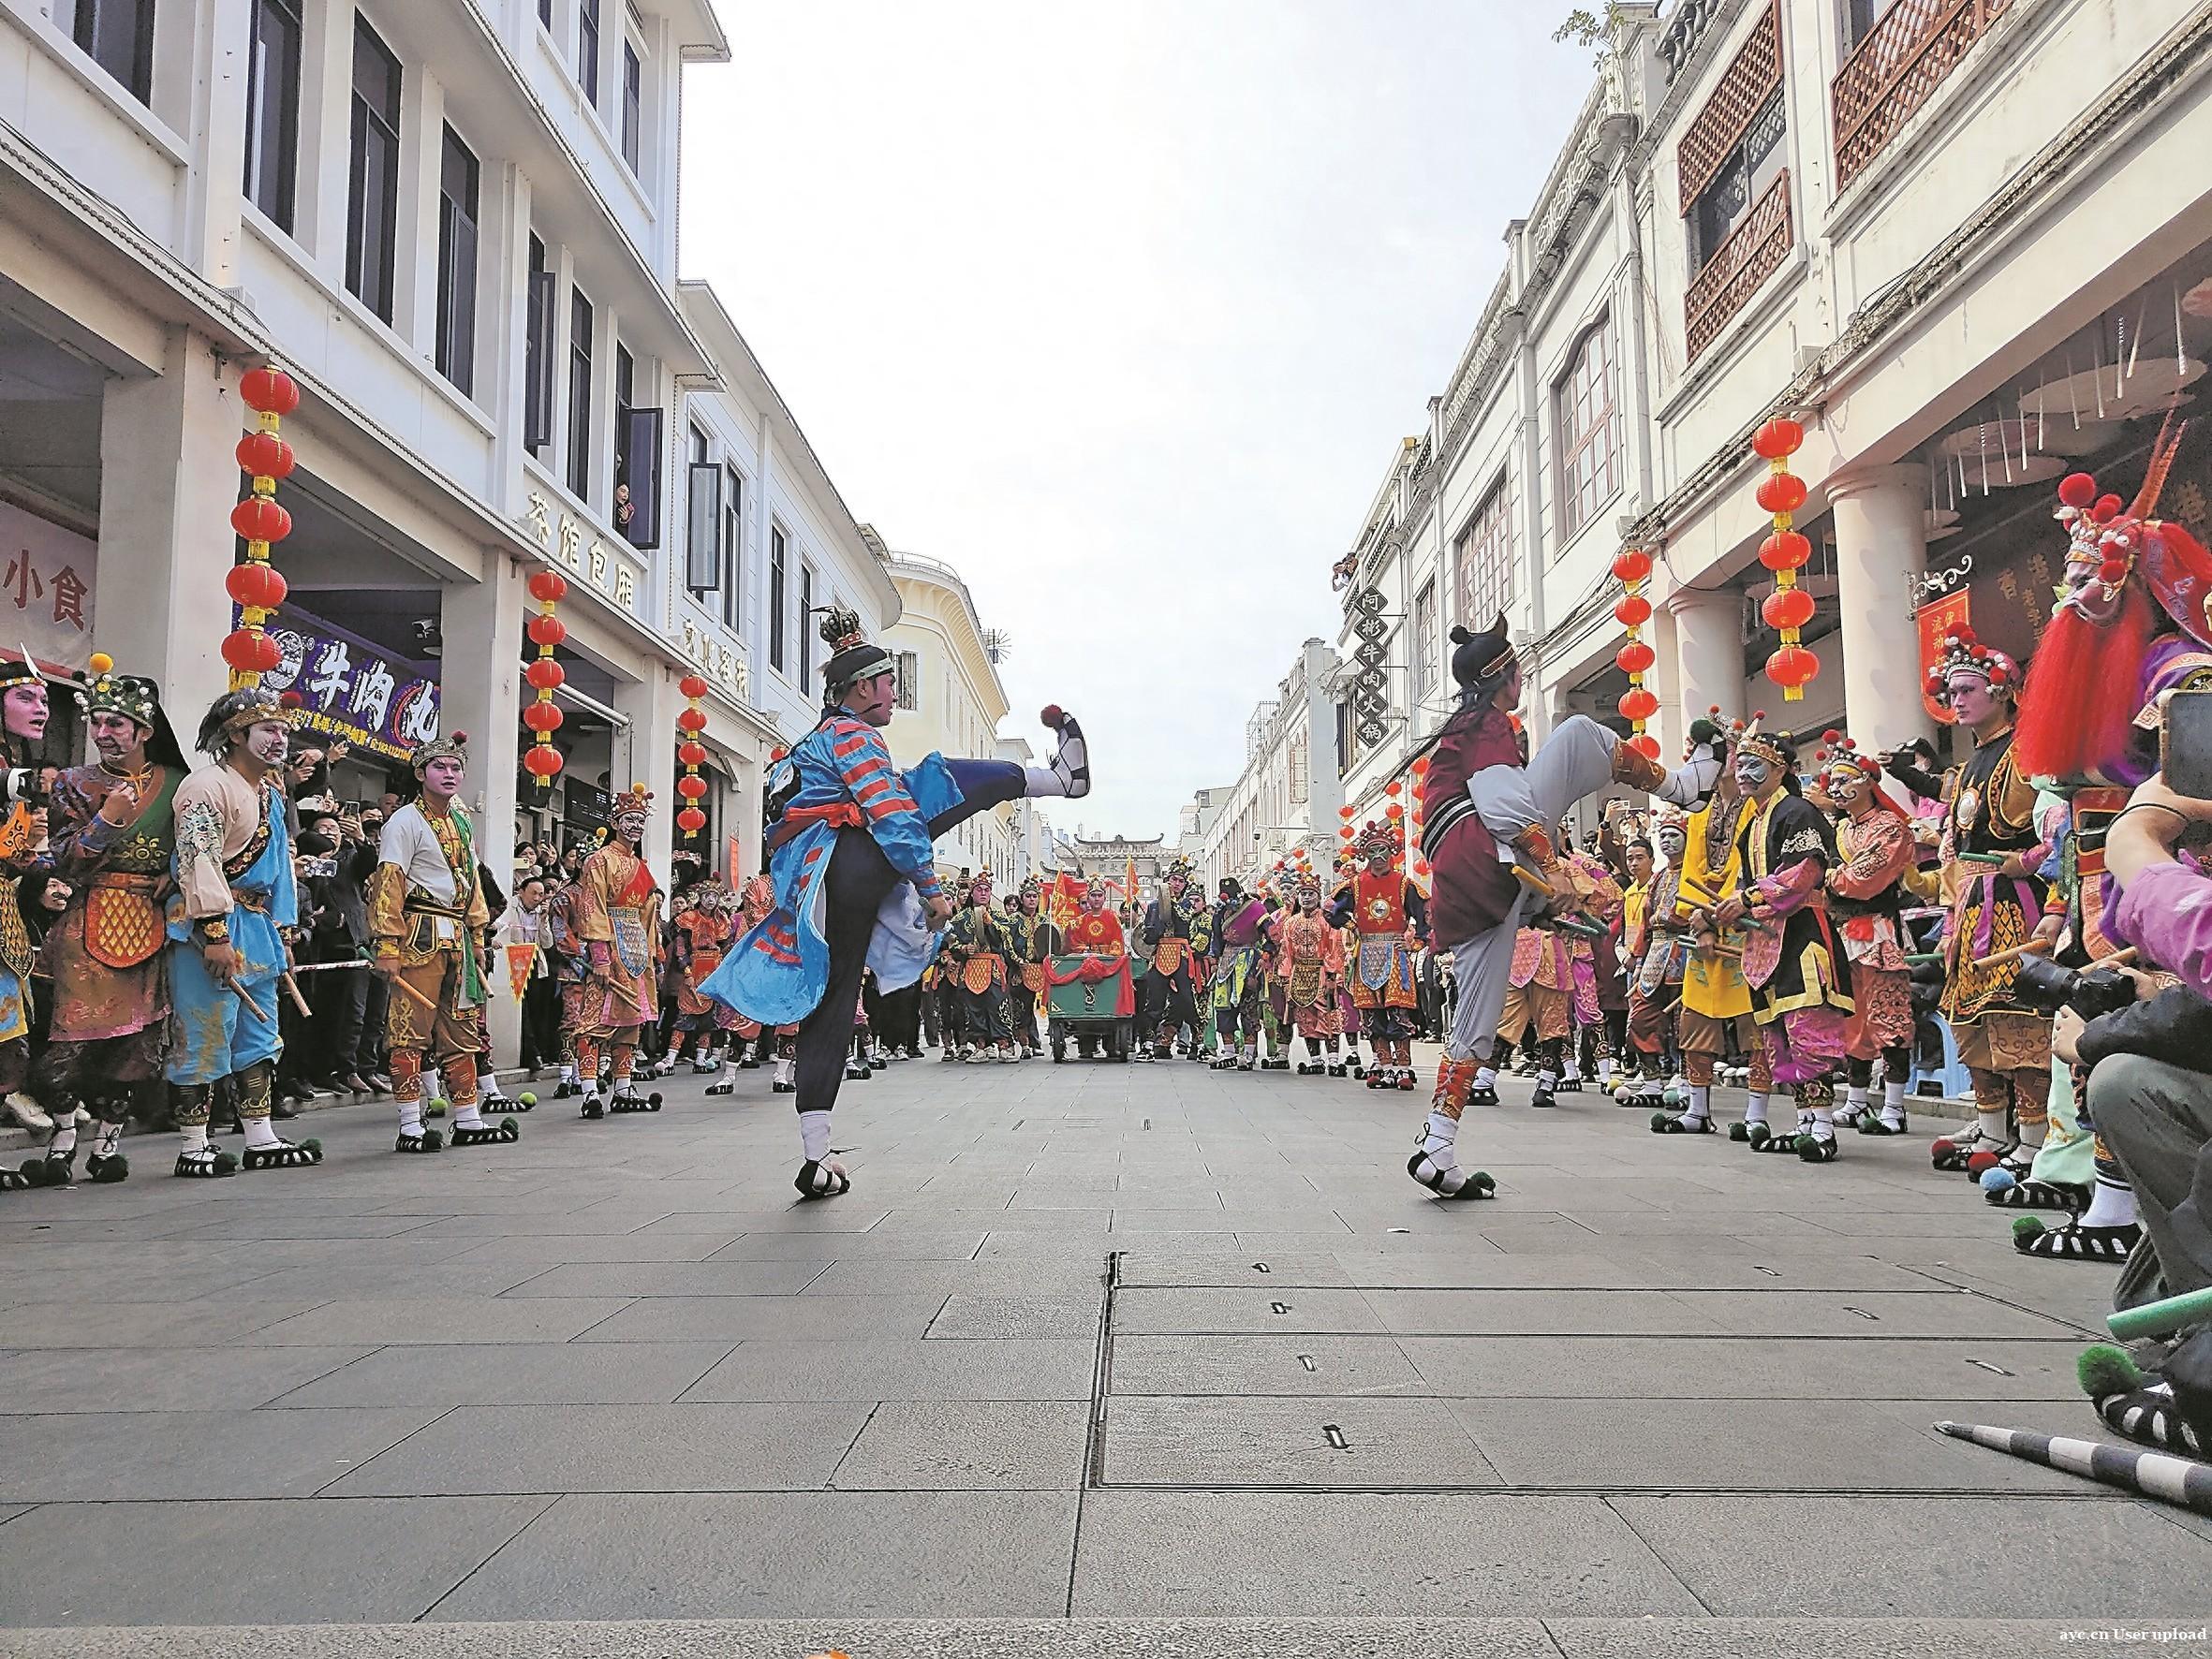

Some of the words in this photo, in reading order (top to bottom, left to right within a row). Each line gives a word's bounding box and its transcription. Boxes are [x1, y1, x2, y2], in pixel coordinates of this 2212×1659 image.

[525, 491, 634, 611] 茶馆包厢
[312, 641, 439, 743] 牛肉丸
[1361, 593, 1382, 740] 阿彬牛肉火锅
